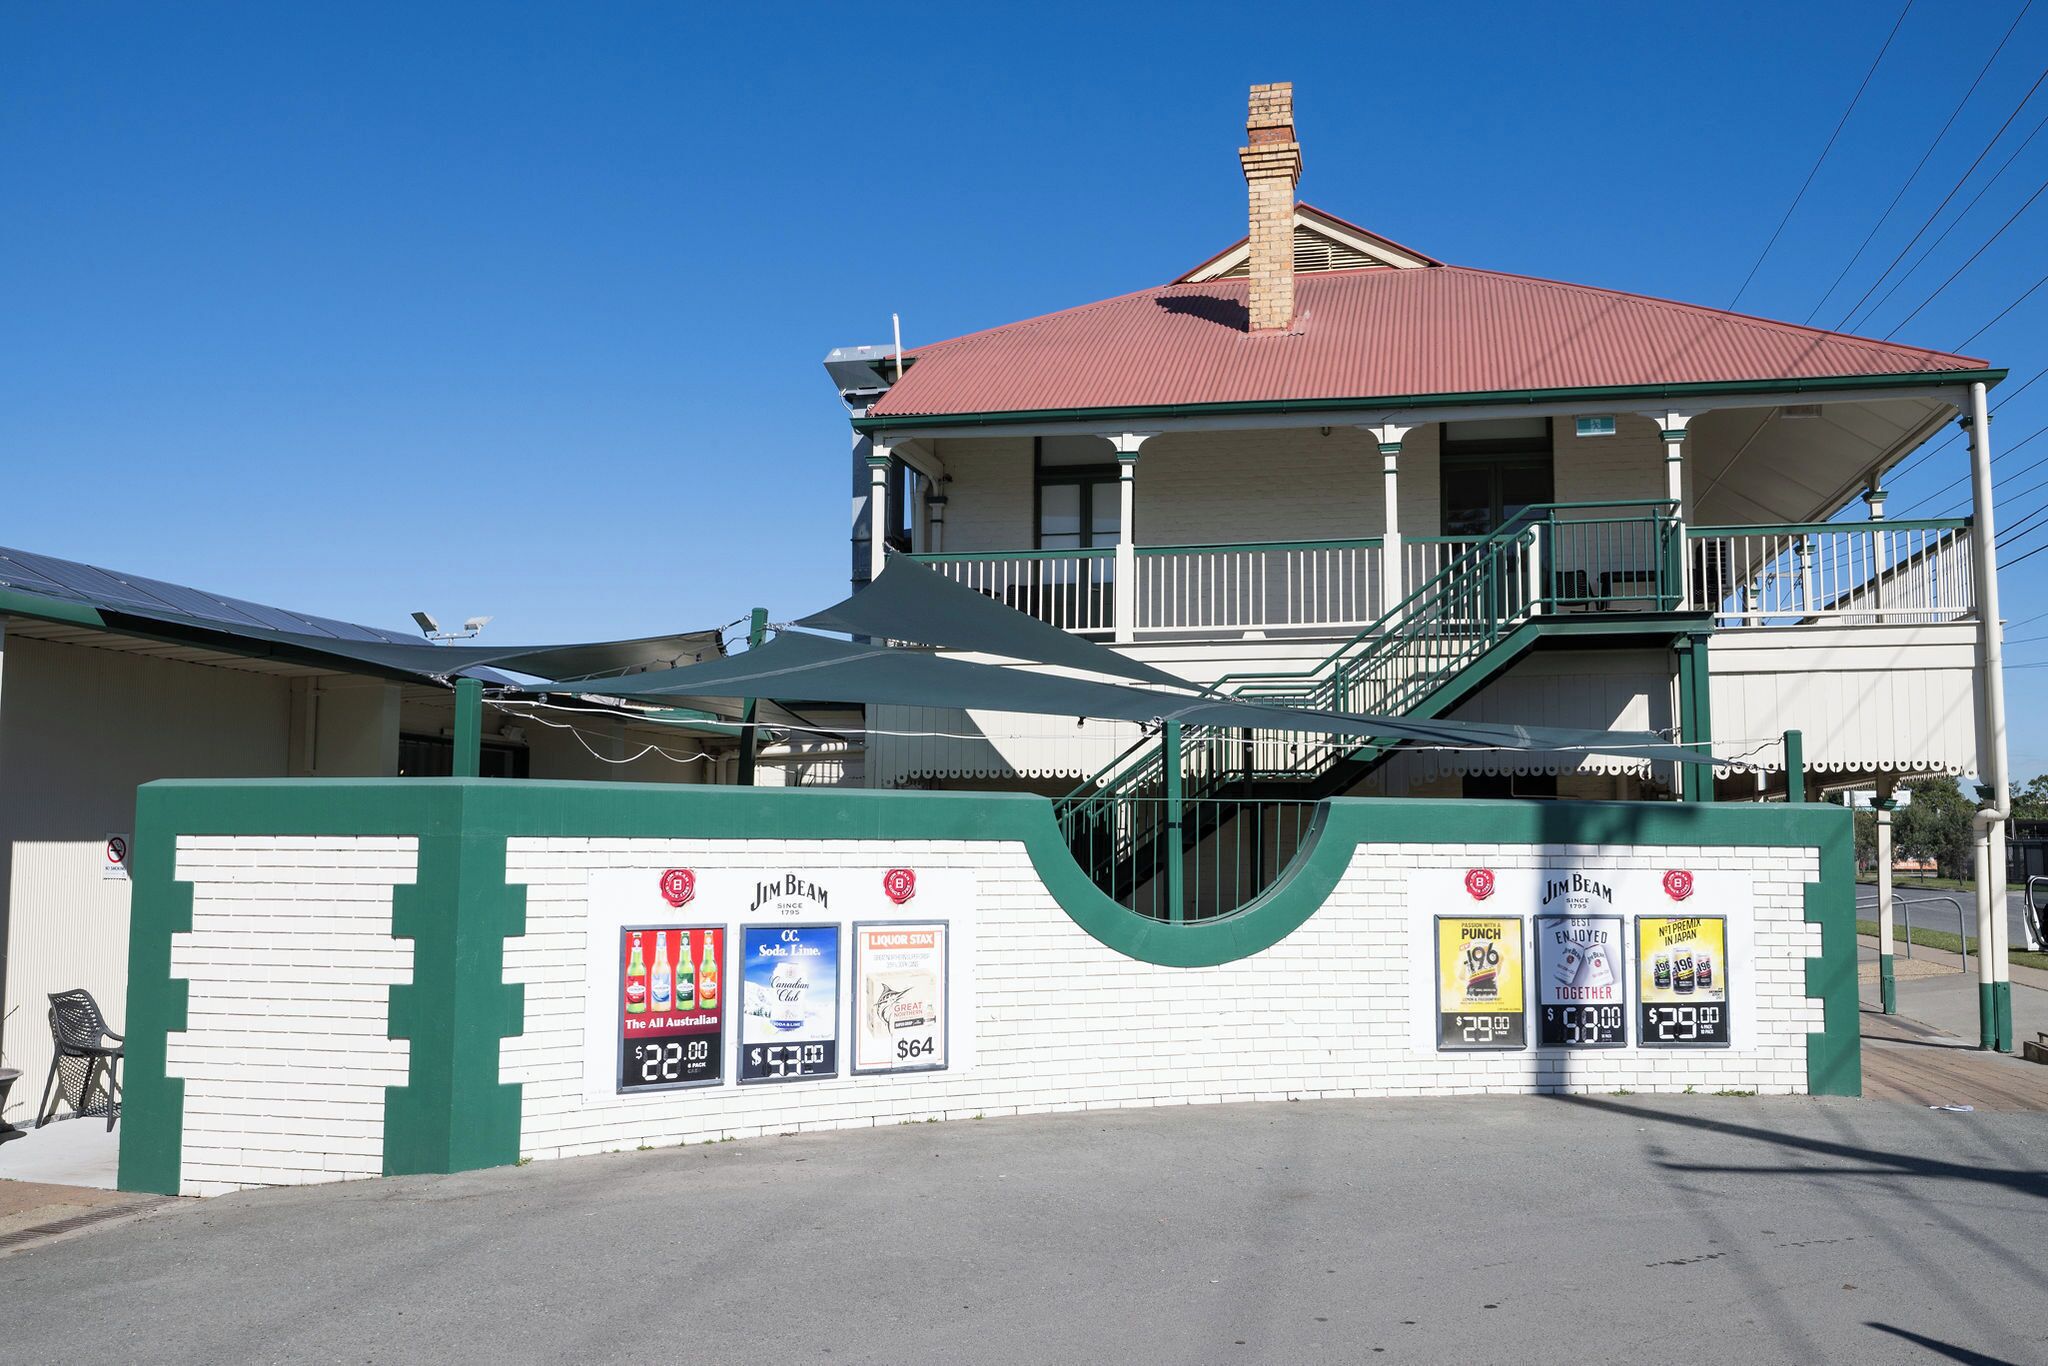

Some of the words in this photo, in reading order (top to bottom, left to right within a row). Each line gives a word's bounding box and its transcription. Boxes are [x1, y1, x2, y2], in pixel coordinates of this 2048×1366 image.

[674, 880, 682, 890] B
[896, 878, 904, 888] B
[1476, 877, 1483, 886] B
[1674, 878, 1682, 888] B
[750, 880, 780, 911] JIM
[785, 874, 828, 909] BEAM
[1543, 880, 1569, 905] JIM
[1573, 874, 1612, 904] BEAM
[1571, 918, 1590, 927] BEST
[1672, 918, 1701, 934] PREMIX
[781, 930, 800, 942] CC.
[871, 934, 908, 947] LIQUOR
[909, 933, 933, 945] STAX
[1461, 928, 1501, 940] PUNCH
[1555, 929, 1608, 944] ENJOYED
[1665, 936, 1673, 946] IN
[1674, 929, 1697, 943] JAPAN
[759, 944, 788, 956] Soda.
[791, 943, 821, 956] Lime.
[769, 976, 809, 989] Canadian
[776, 989, 801, 1001] Club
[1555, 986, 1612, 1000] TOGETHER
[894, 1002, 922, 1012] GREAT
[894, 1010, 922, 1018] NORTHERN
[626, 1019, 646, 1029] The
[648, 1018, 664, 1028] All
[666, 1015, 717, 1027] Australian
[897, 1037, 934, 1060] $64
